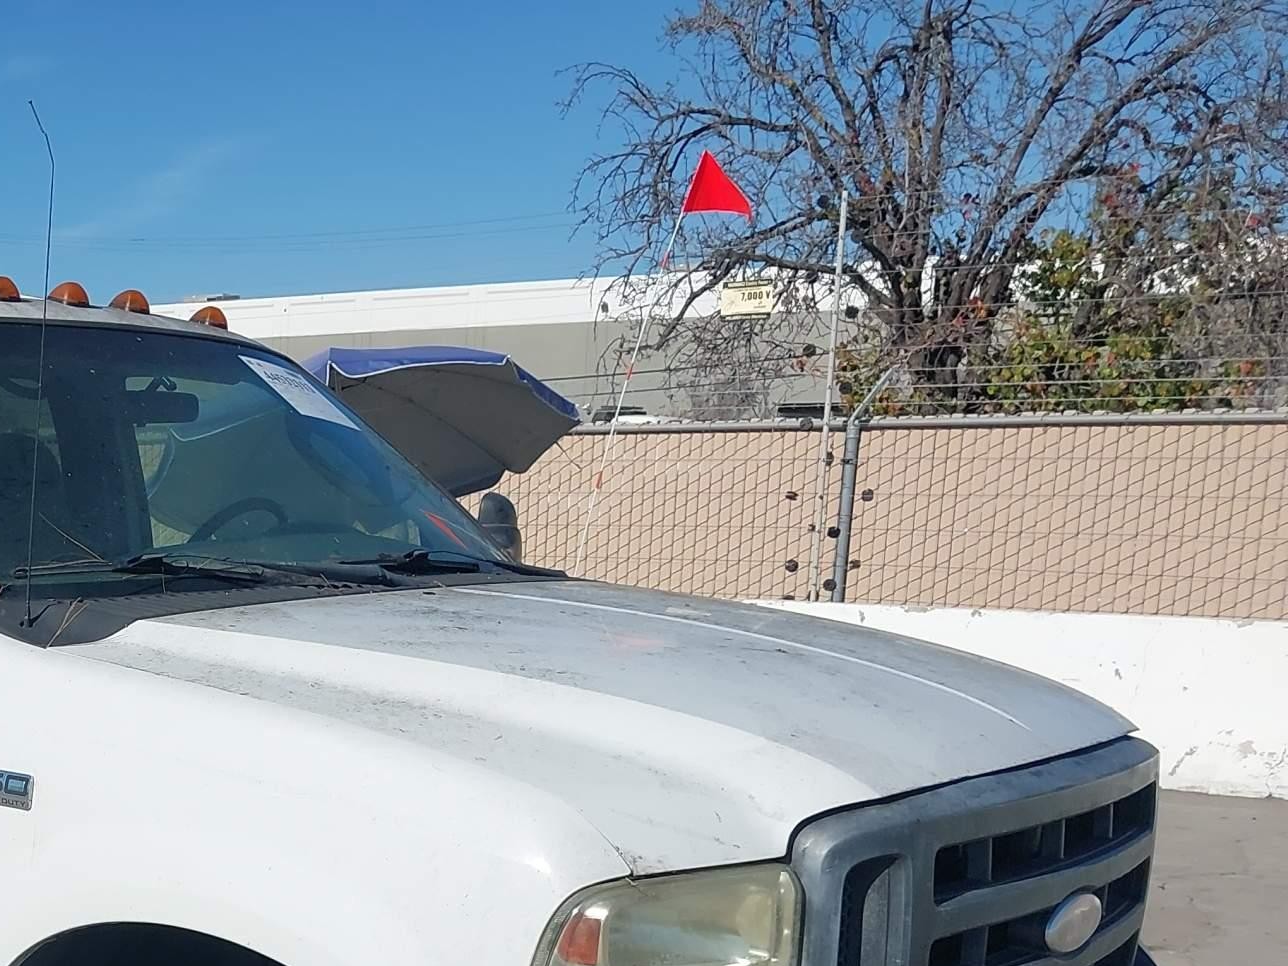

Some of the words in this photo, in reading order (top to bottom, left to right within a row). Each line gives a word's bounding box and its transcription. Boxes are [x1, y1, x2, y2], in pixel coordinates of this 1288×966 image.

[740, 291, 764, 302] 7,000
[765, 290, 771, 299] V
[1, 797, 26, 807] DUTY
